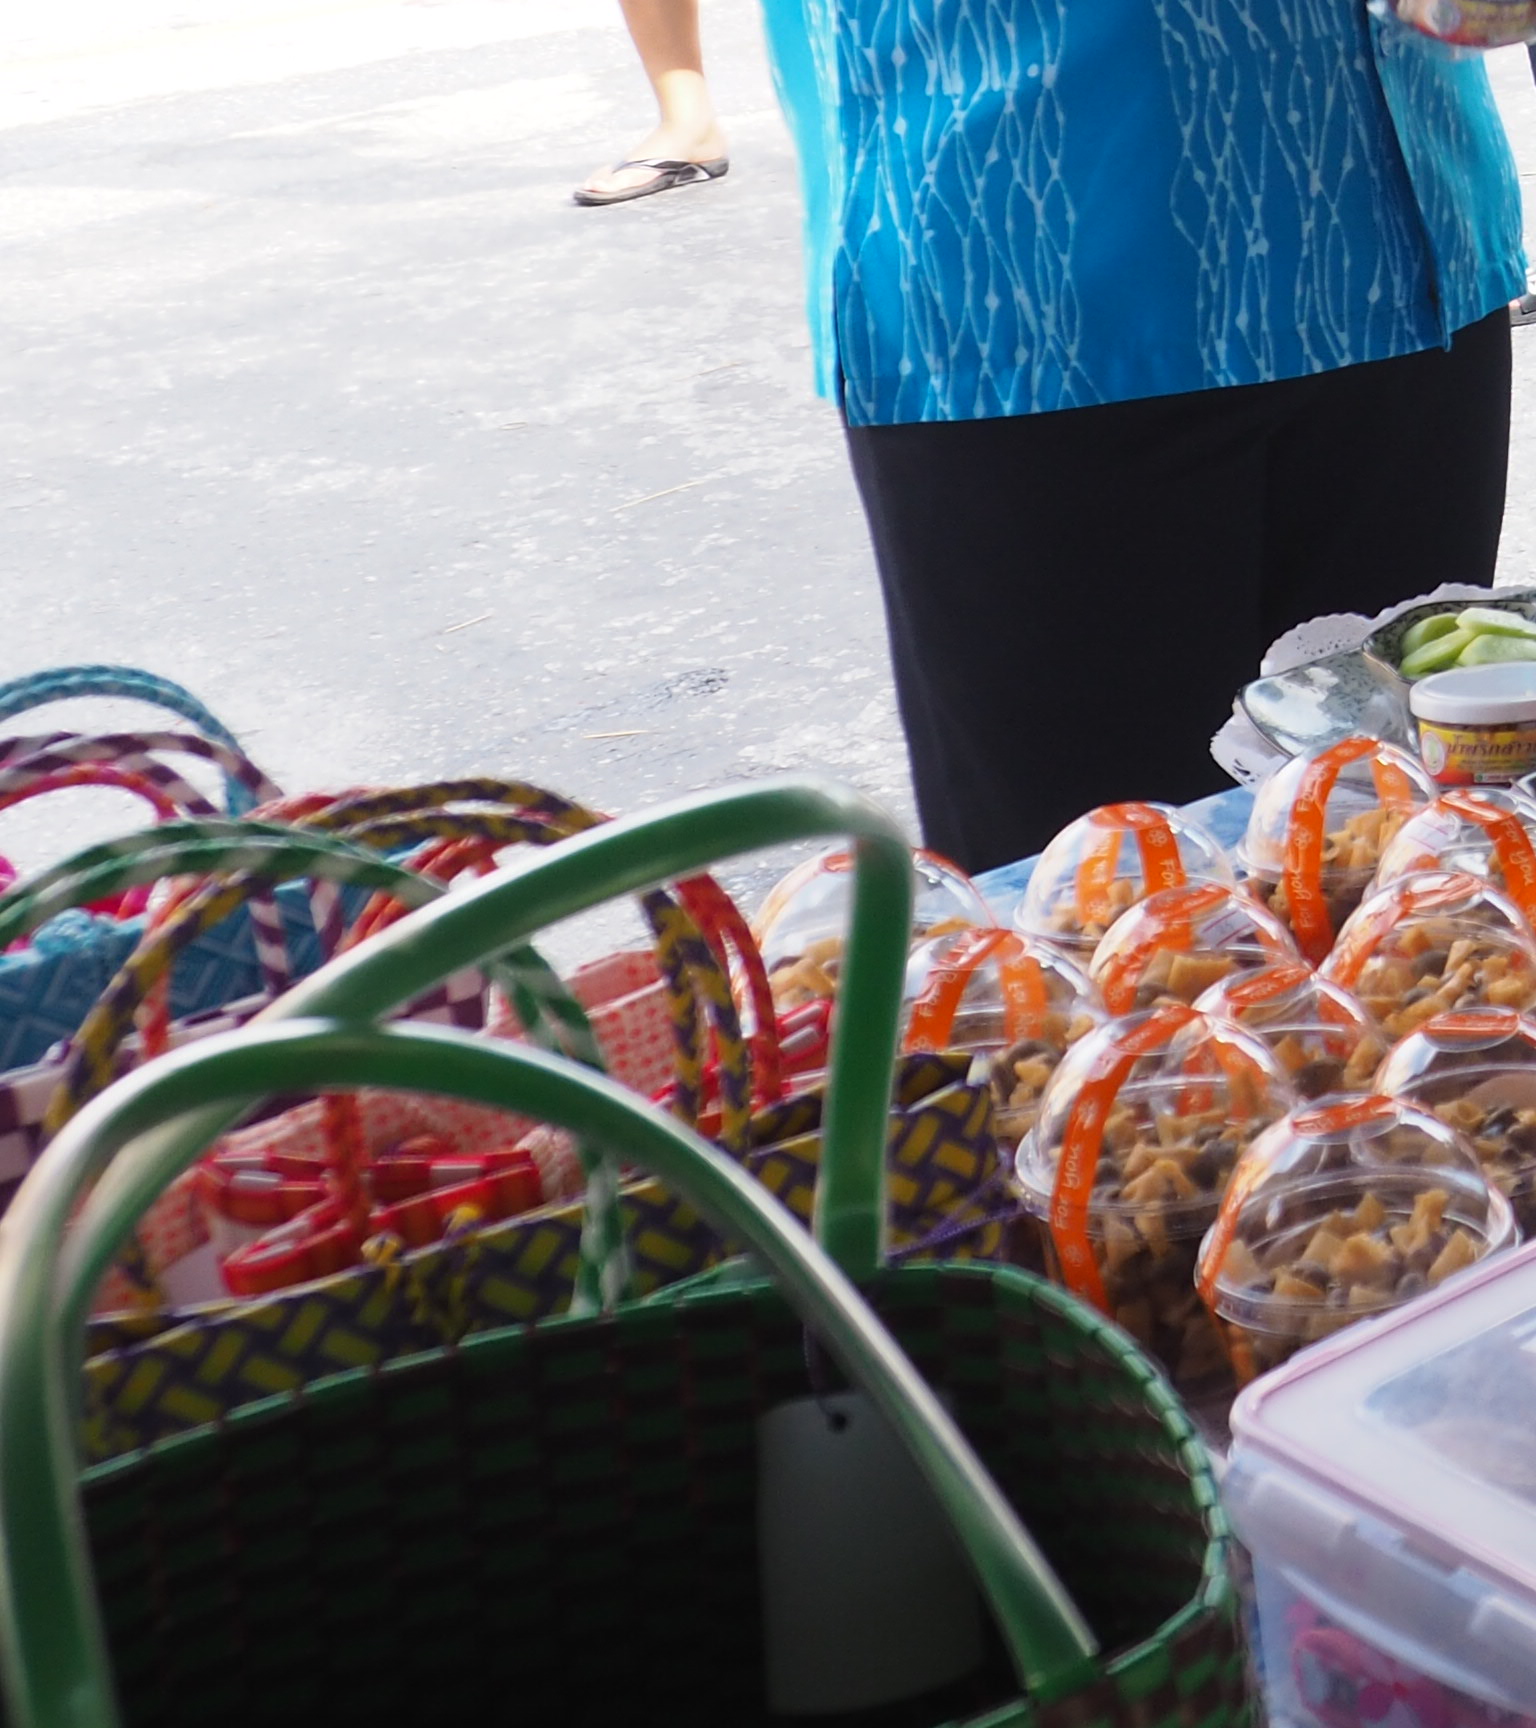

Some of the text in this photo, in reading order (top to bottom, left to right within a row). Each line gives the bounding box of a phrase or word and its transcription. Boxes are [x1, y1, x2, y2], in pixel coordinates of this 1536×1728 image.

[1509, 850, 1533, 885] you
[1054, 1142, 1081, 1230] For you
